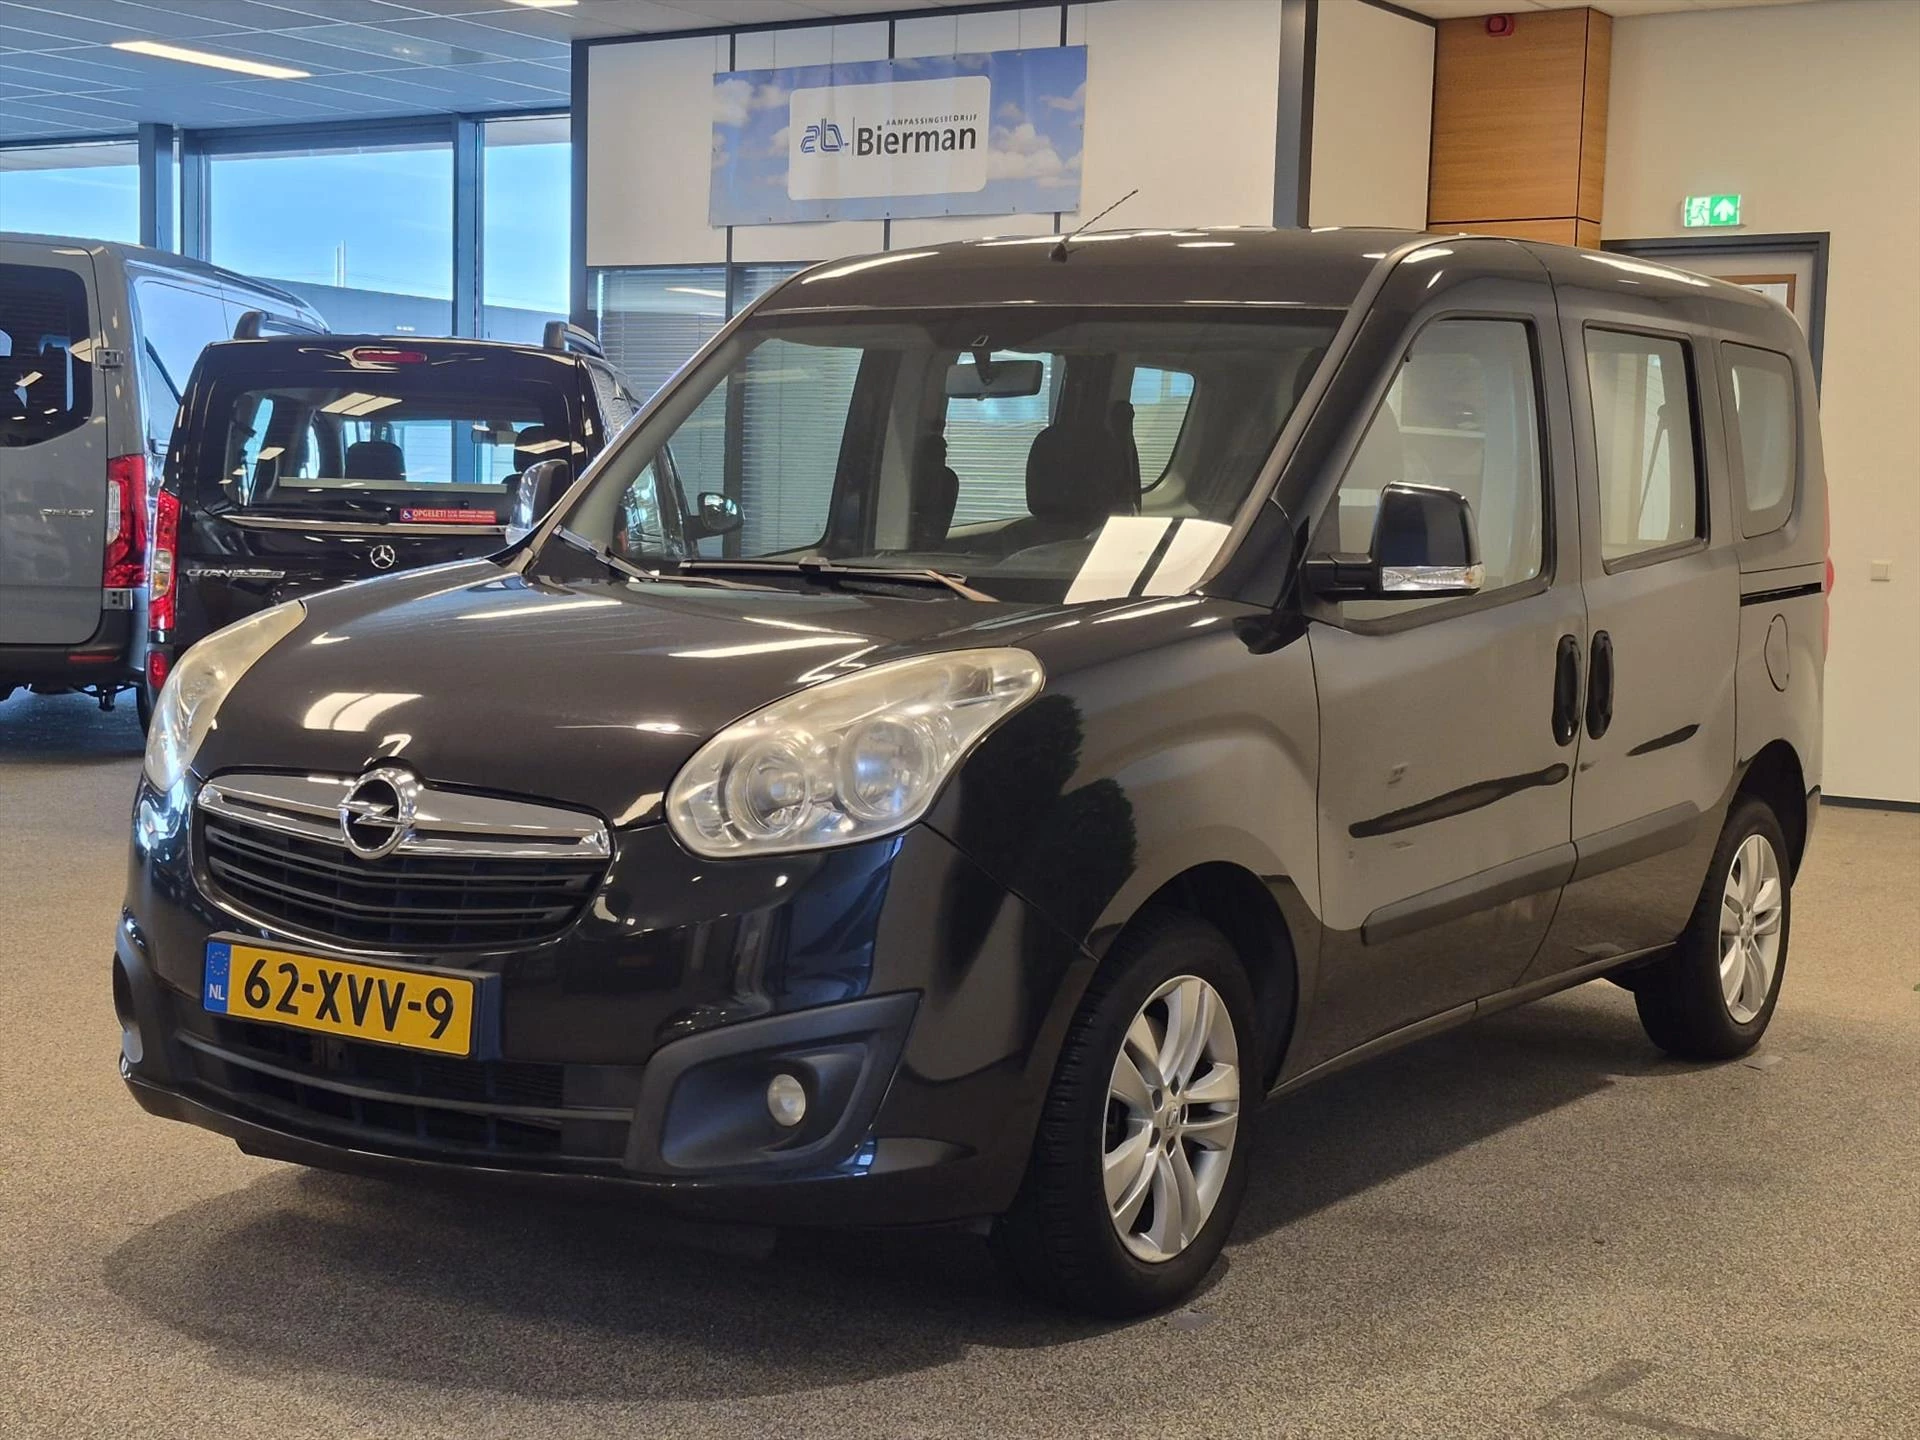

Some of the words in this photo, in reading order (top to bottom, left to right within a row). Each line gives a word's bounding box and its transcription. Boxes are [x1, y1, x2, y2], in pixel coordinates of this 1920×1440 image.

[857, 125, 977, 156] Bierman
[209, 983, 225, 1001] NL
[244, 958, 454, 1040] 62-XVV-9
